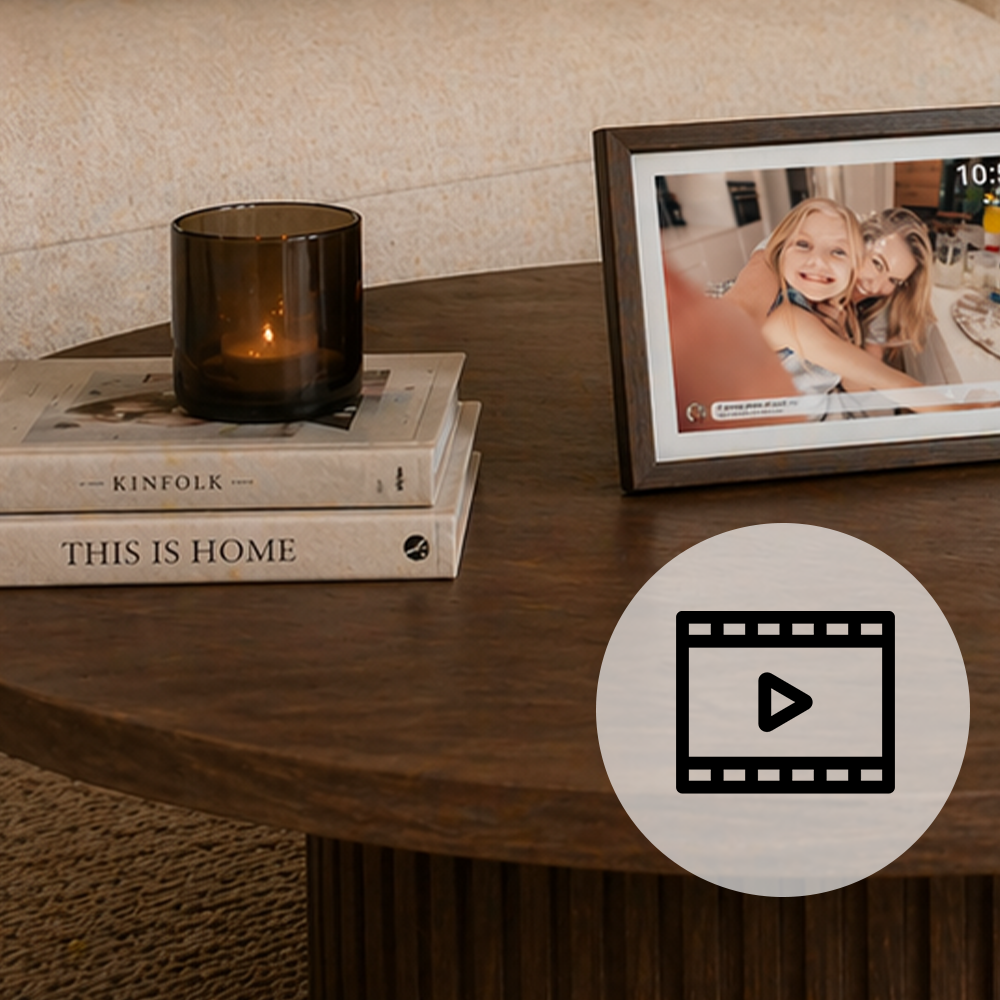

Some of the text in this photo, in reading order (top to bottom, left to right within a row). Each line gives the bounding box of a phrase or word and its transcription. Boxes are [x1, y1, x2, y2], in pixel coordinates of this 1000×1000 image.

[112, 474, 223, 491] KINFOLK
[61, 537, 297, 566] THIS IS HOME
